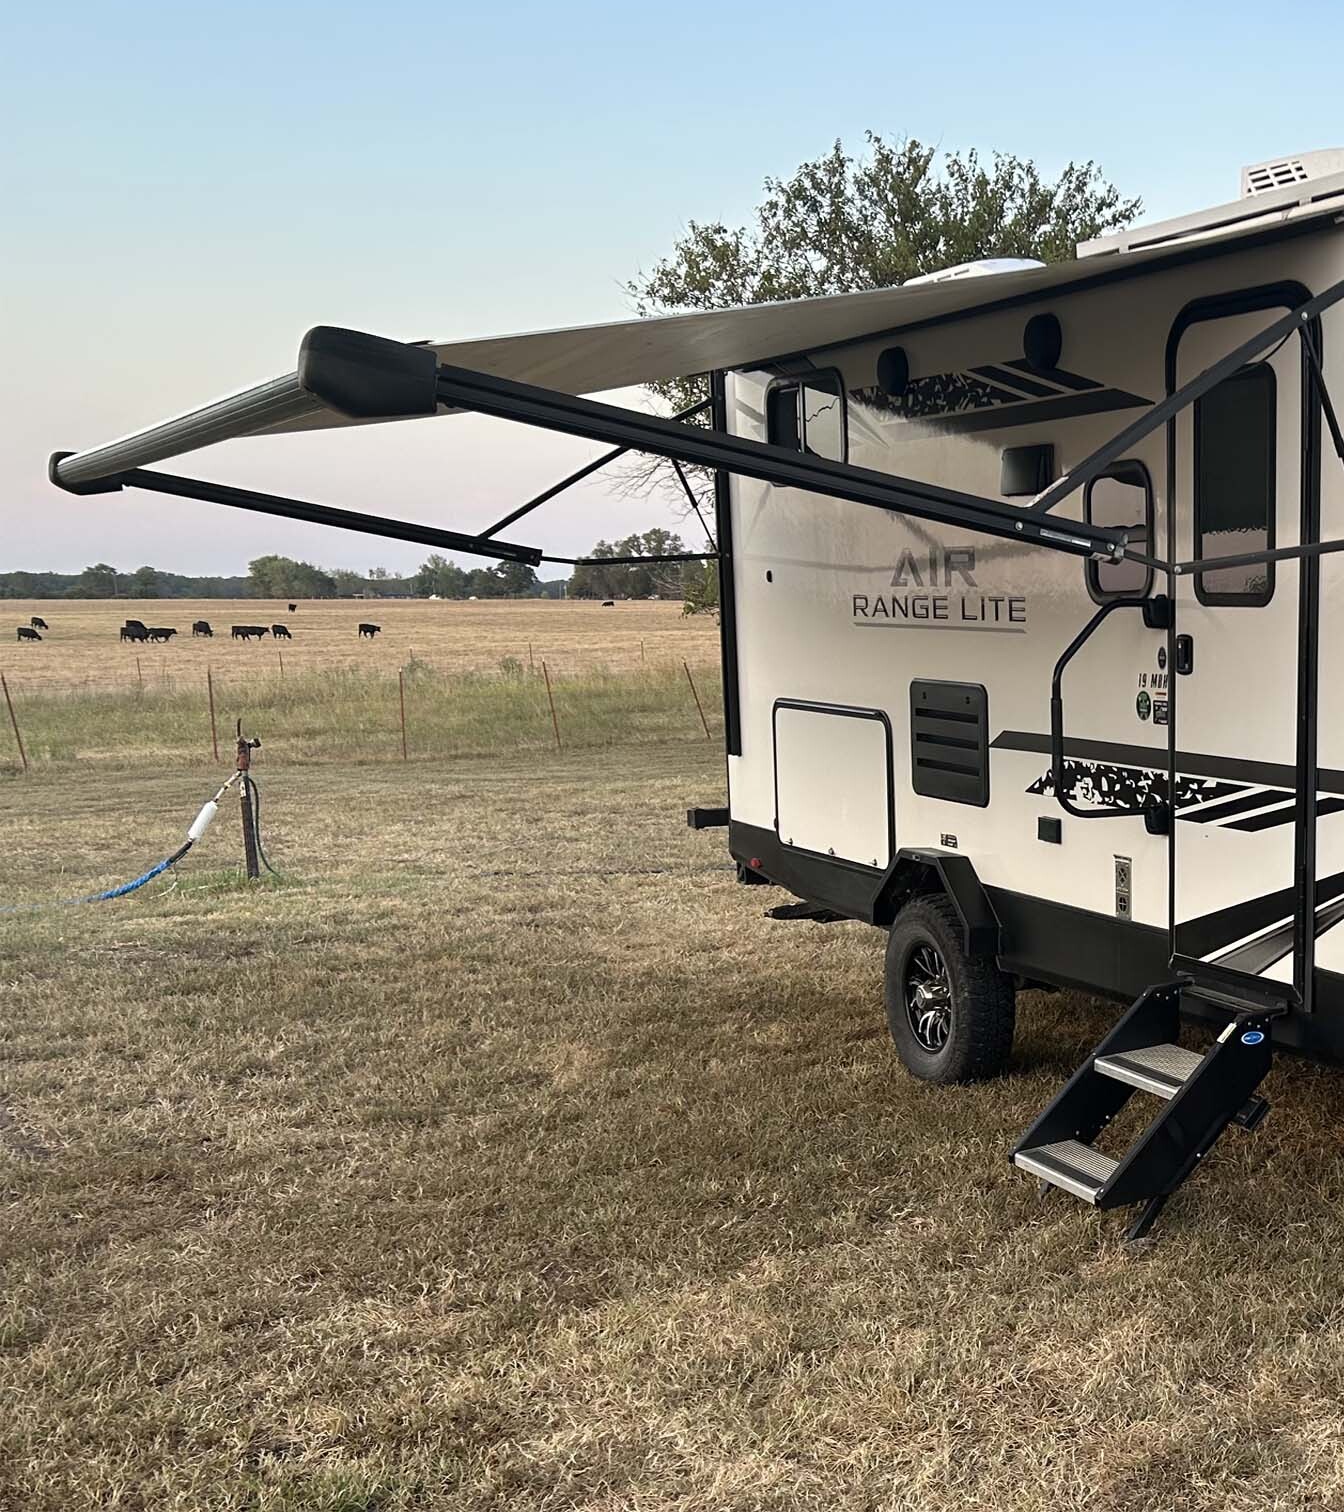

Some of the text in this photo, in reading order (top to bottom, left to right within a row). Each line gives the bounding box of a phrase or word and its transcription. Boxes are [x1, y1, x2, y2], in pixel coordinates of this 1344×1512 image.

[890, 546, 978, 588] AIR
[852, 594, 1027, 622] RANGE LITE
[1138, 673, 1147, 688] 19
